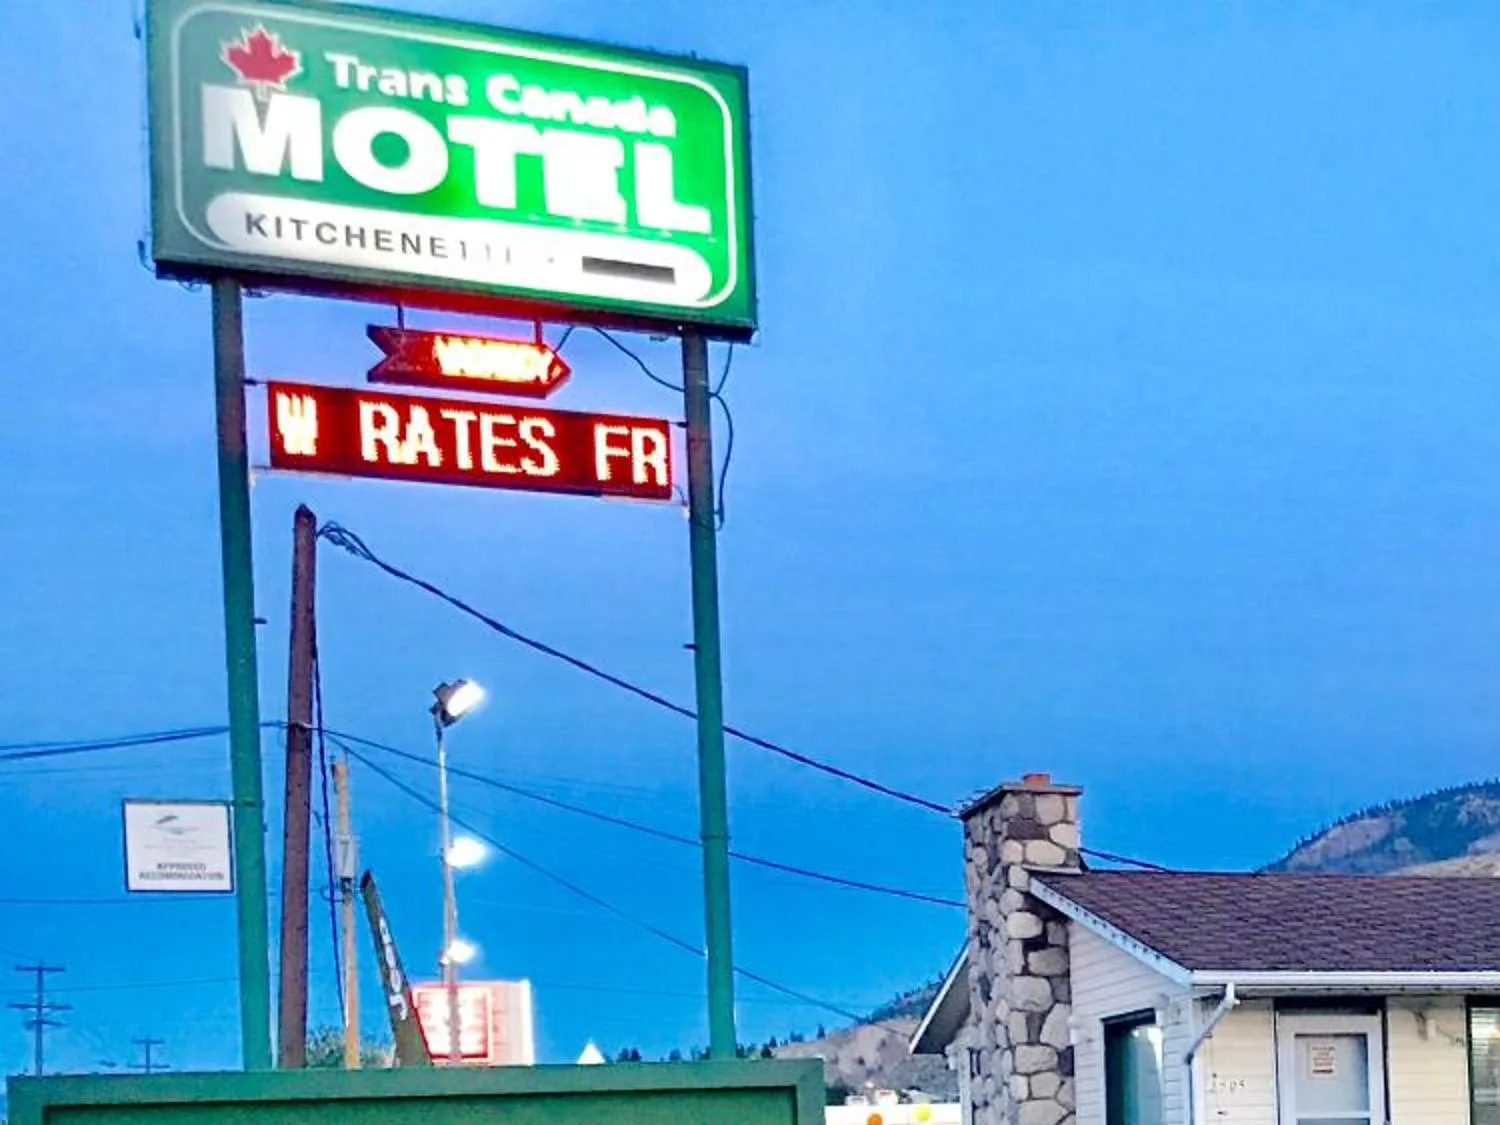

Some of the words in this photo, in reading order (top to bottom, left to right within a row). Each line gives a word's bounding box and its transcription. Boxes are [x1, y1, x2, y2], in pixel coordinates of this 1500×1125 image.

[324, 52, 470, 107] Trans
[485, 74, 677, 138] Canada
[201, 82, 712, 234] MOTEL
[358, 401, 560, 478] RATES
[593, 423, 669, 487] FR
